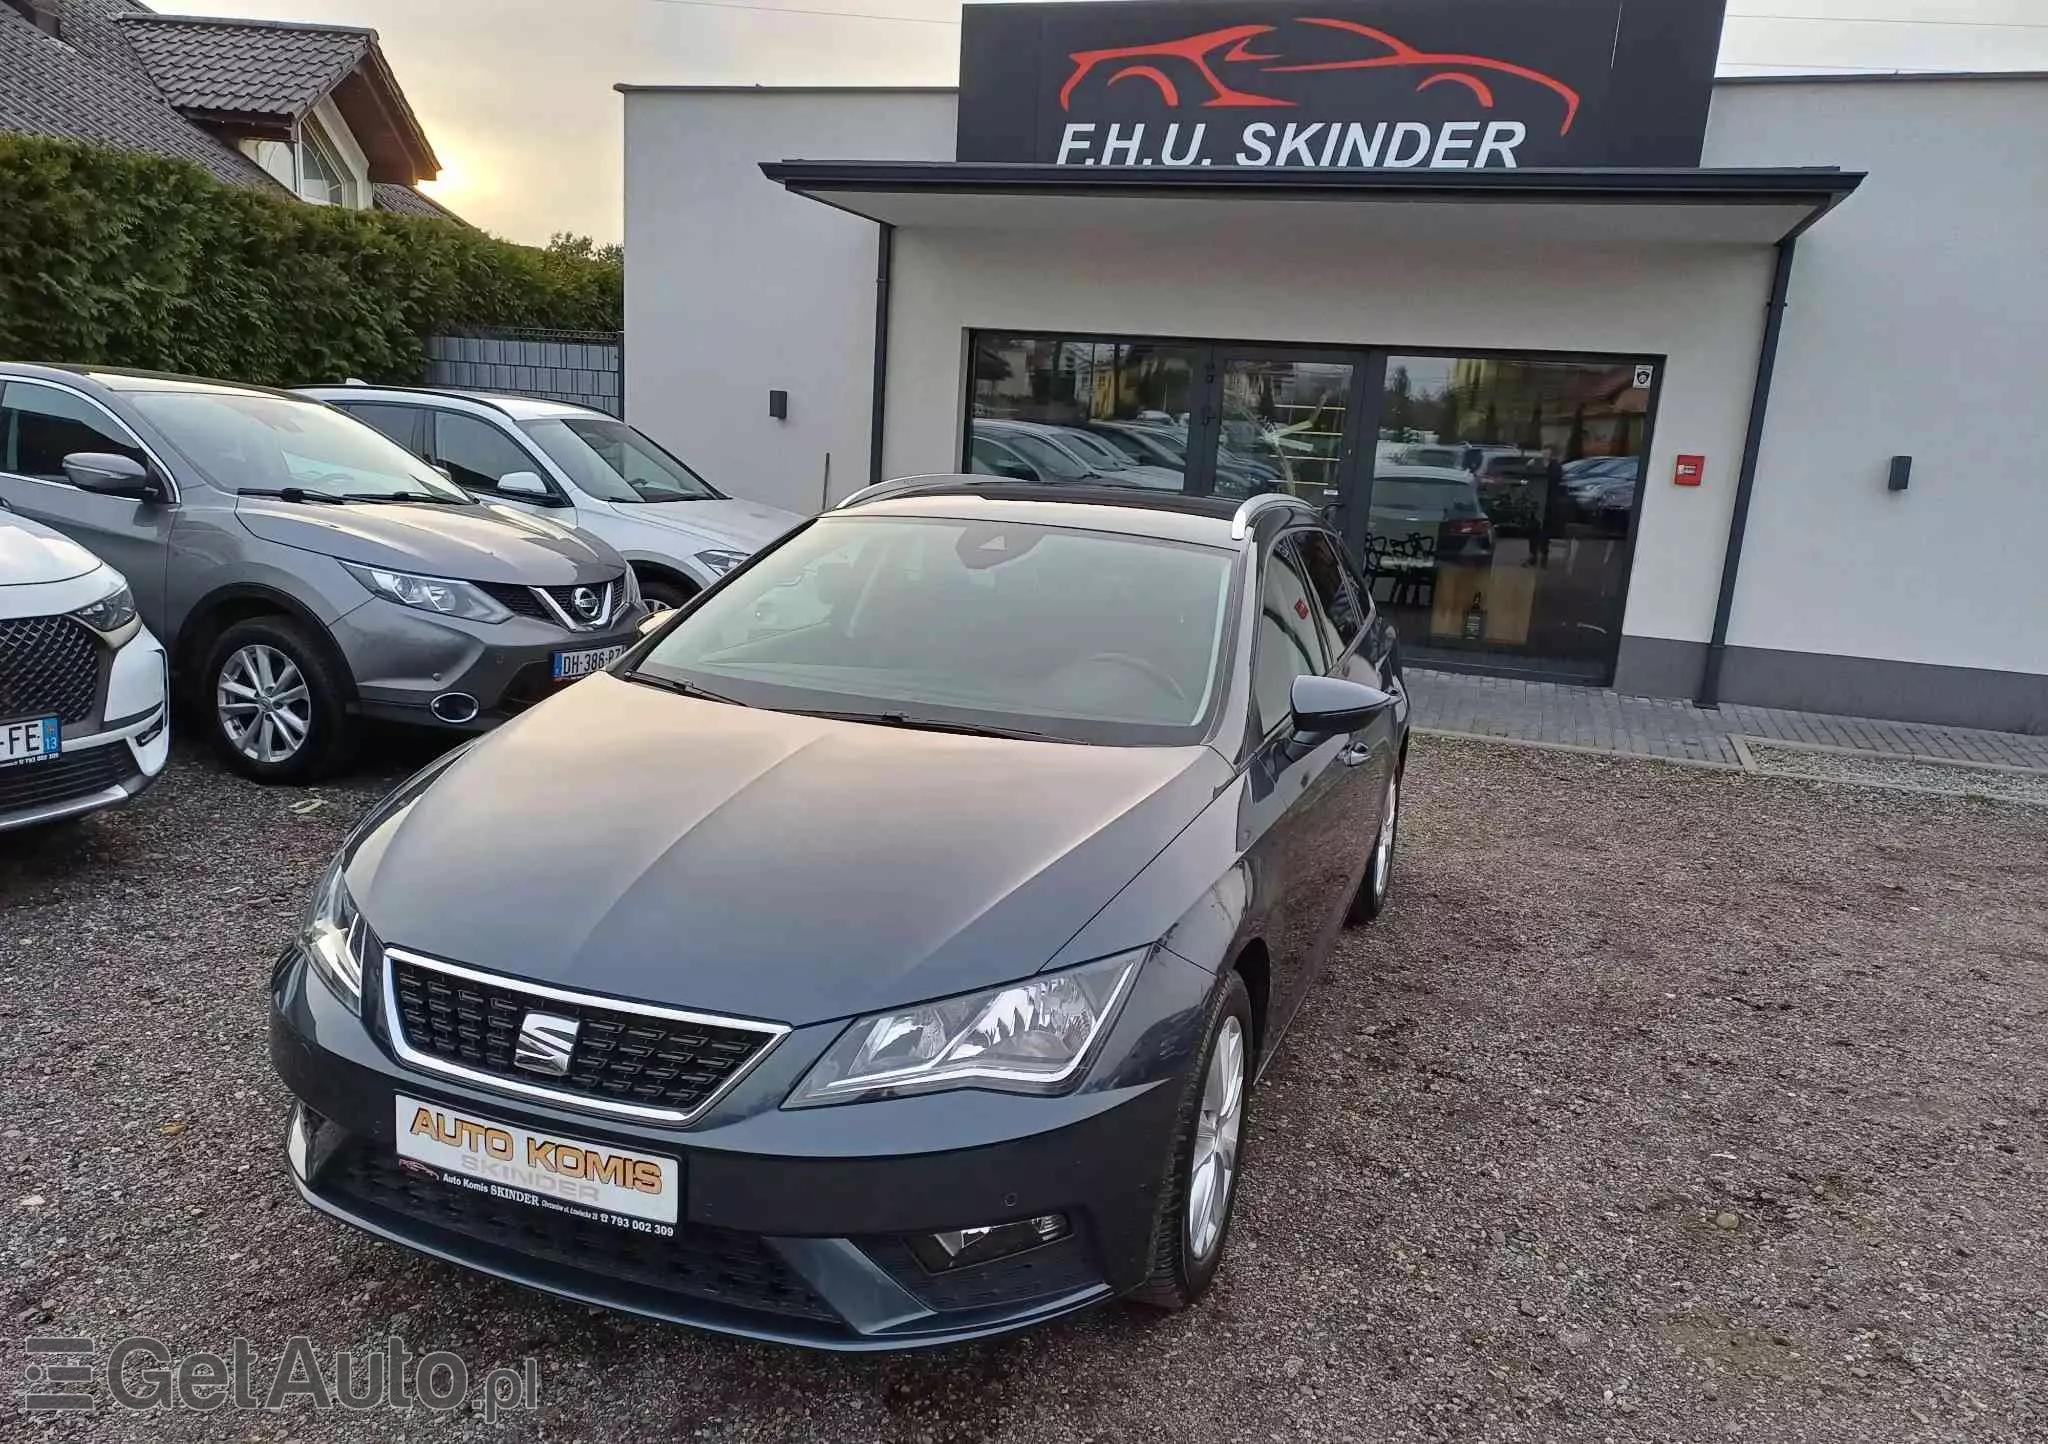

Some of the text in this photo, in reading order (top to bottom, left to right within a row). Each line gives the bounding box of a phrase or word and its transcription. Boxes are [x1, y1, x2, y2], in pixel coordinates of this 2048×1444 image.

[1056, 121, 1526, 168] F.H.U. SKINDER
[46, 736, 57, 750] 13
[409, 1106, 663, 1195] AUTO KOMIS
[461, 1154, 600, 1201] SKINDER
[442, 1173, 461, 1186] Auto
[463, 1178, 489, 1193] Komis
[491, 1184, 540, 1207] SKINDER
[611, 1215, 630, 1228] 793
[632, 1220, 652, 1233] 002
[654, 1224, 674, 1237] 309
